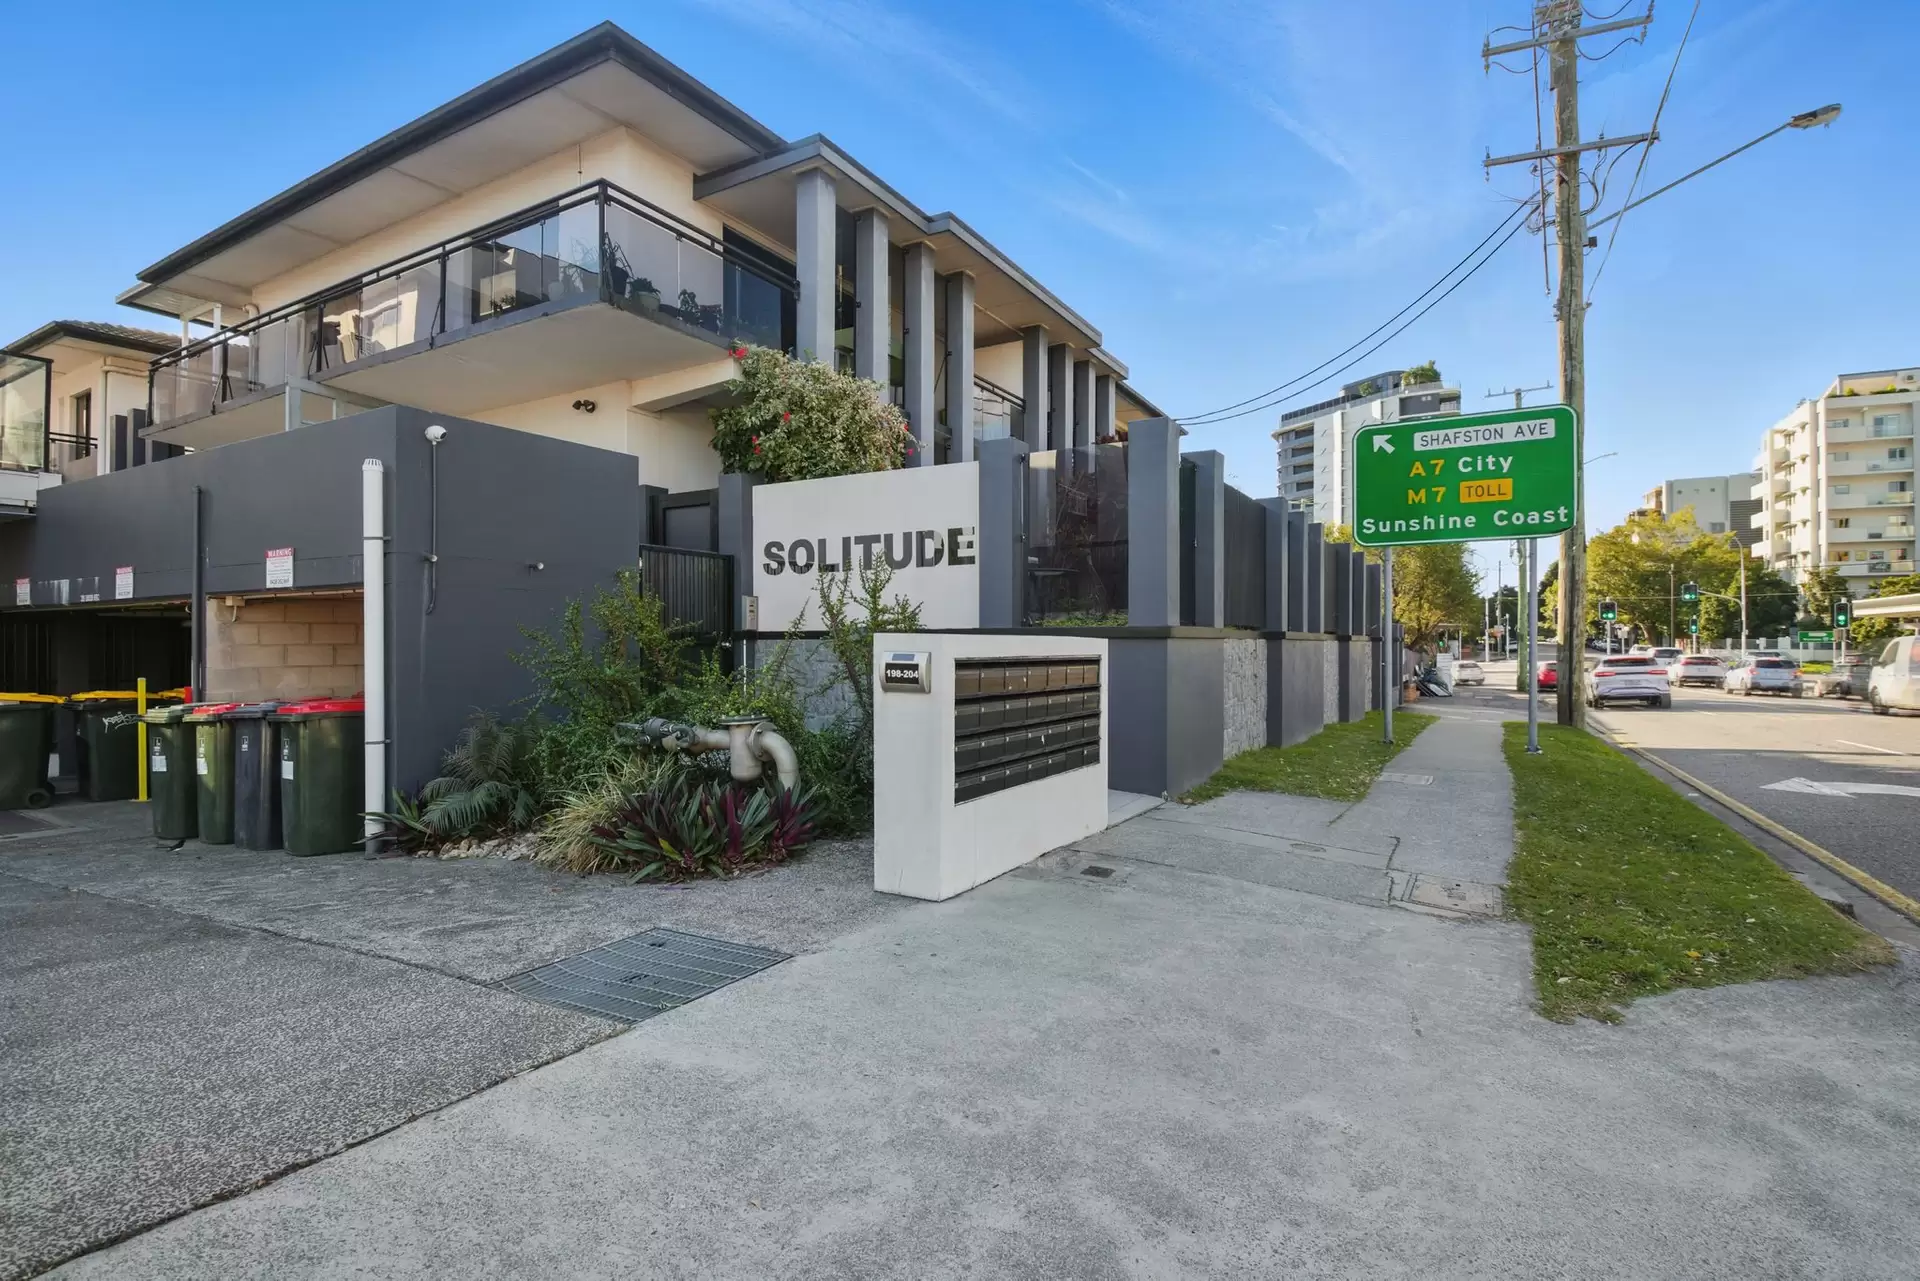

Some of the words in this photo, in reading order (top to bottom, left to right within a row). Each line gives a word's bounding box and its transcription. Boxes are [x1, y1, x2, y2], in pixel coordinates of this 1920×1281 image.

[1420, 427, 1504, 447] SHAFSTON
[1514, 422, 1548, 438] AVE
[1458, 455, 1514, 473] City
[1464, 484, 1507, 498] TOLL
[1362, 515, 1477, 534] Sunshine
[1493, 506, 1568, 526] Coast
[763, 526, 976, 576] SOLITUDE
[886, 669, 919, 679] 198-204
